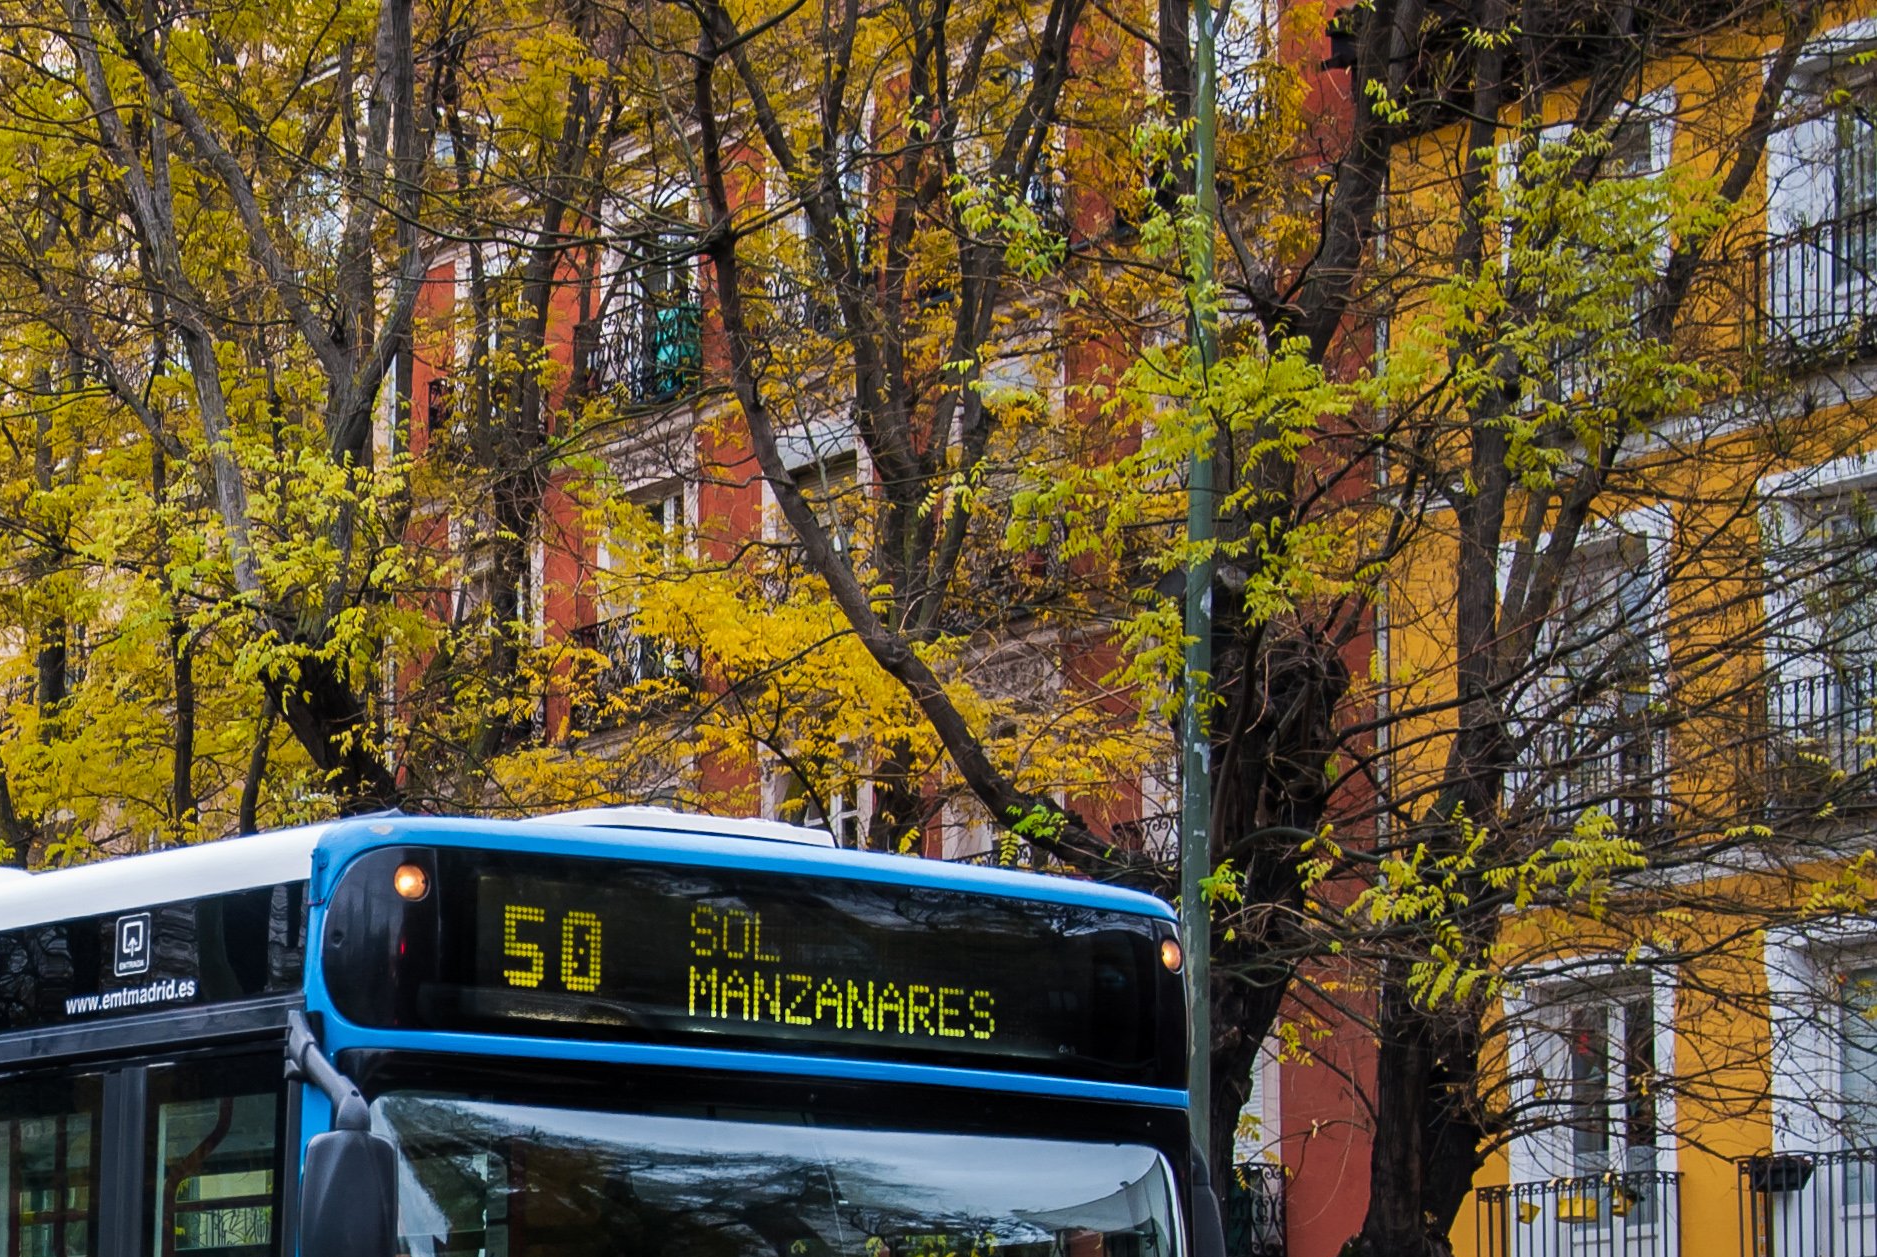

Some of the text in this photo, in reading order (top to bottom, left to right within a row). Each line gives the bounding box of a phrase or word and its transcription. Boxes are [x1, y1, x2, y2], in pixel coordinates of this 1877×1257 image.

[504, 904, 780, 992] 50 SOL
[65, 978, 196, 1015] www.emtmadrid.es
[688, 965, 995, 1040] MANZANARES
